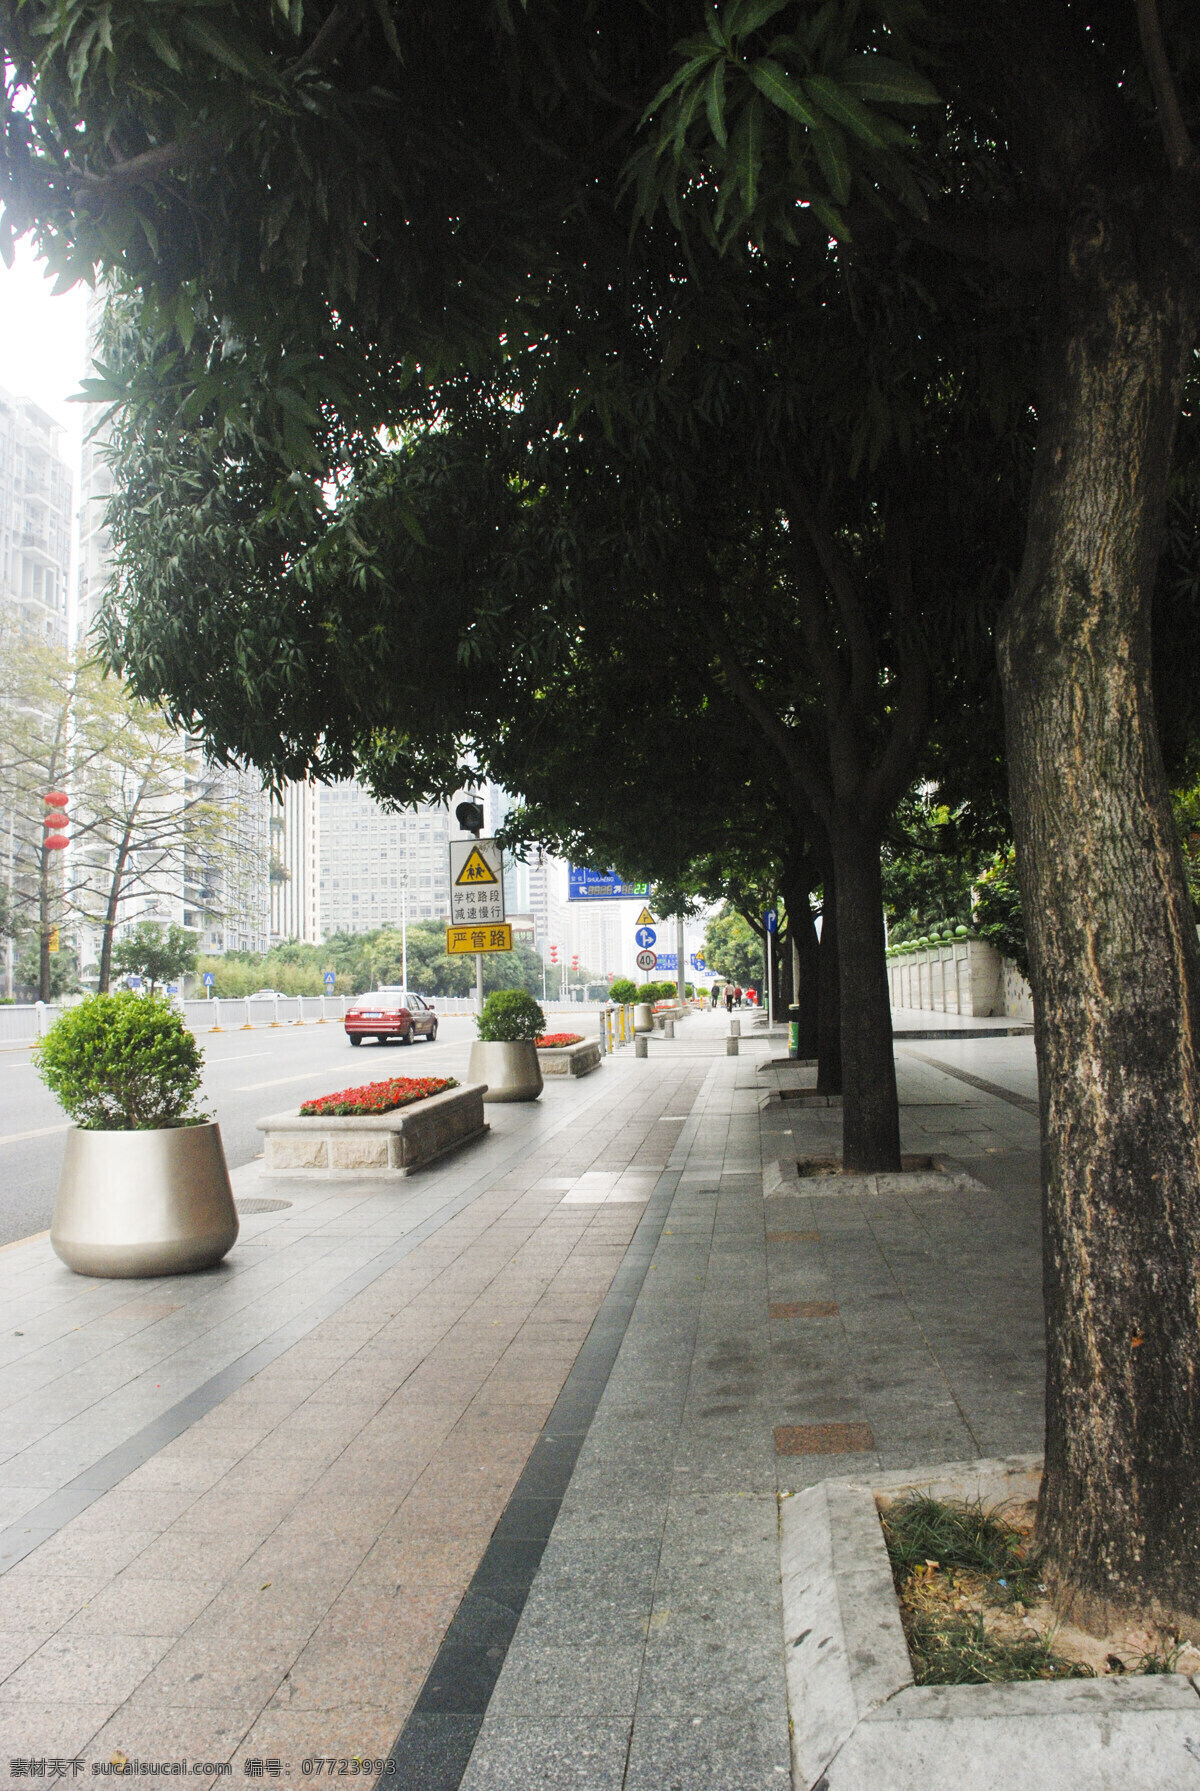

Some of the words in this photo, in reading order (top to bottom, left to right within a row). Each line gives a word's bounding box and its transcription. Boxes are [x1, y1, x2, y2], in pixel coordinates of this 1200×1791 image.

[454, 890, 500, 904] 学校路段
[455, 905, 501, 920] 减速慢行
[452, 929, 506, 949] 严管路
